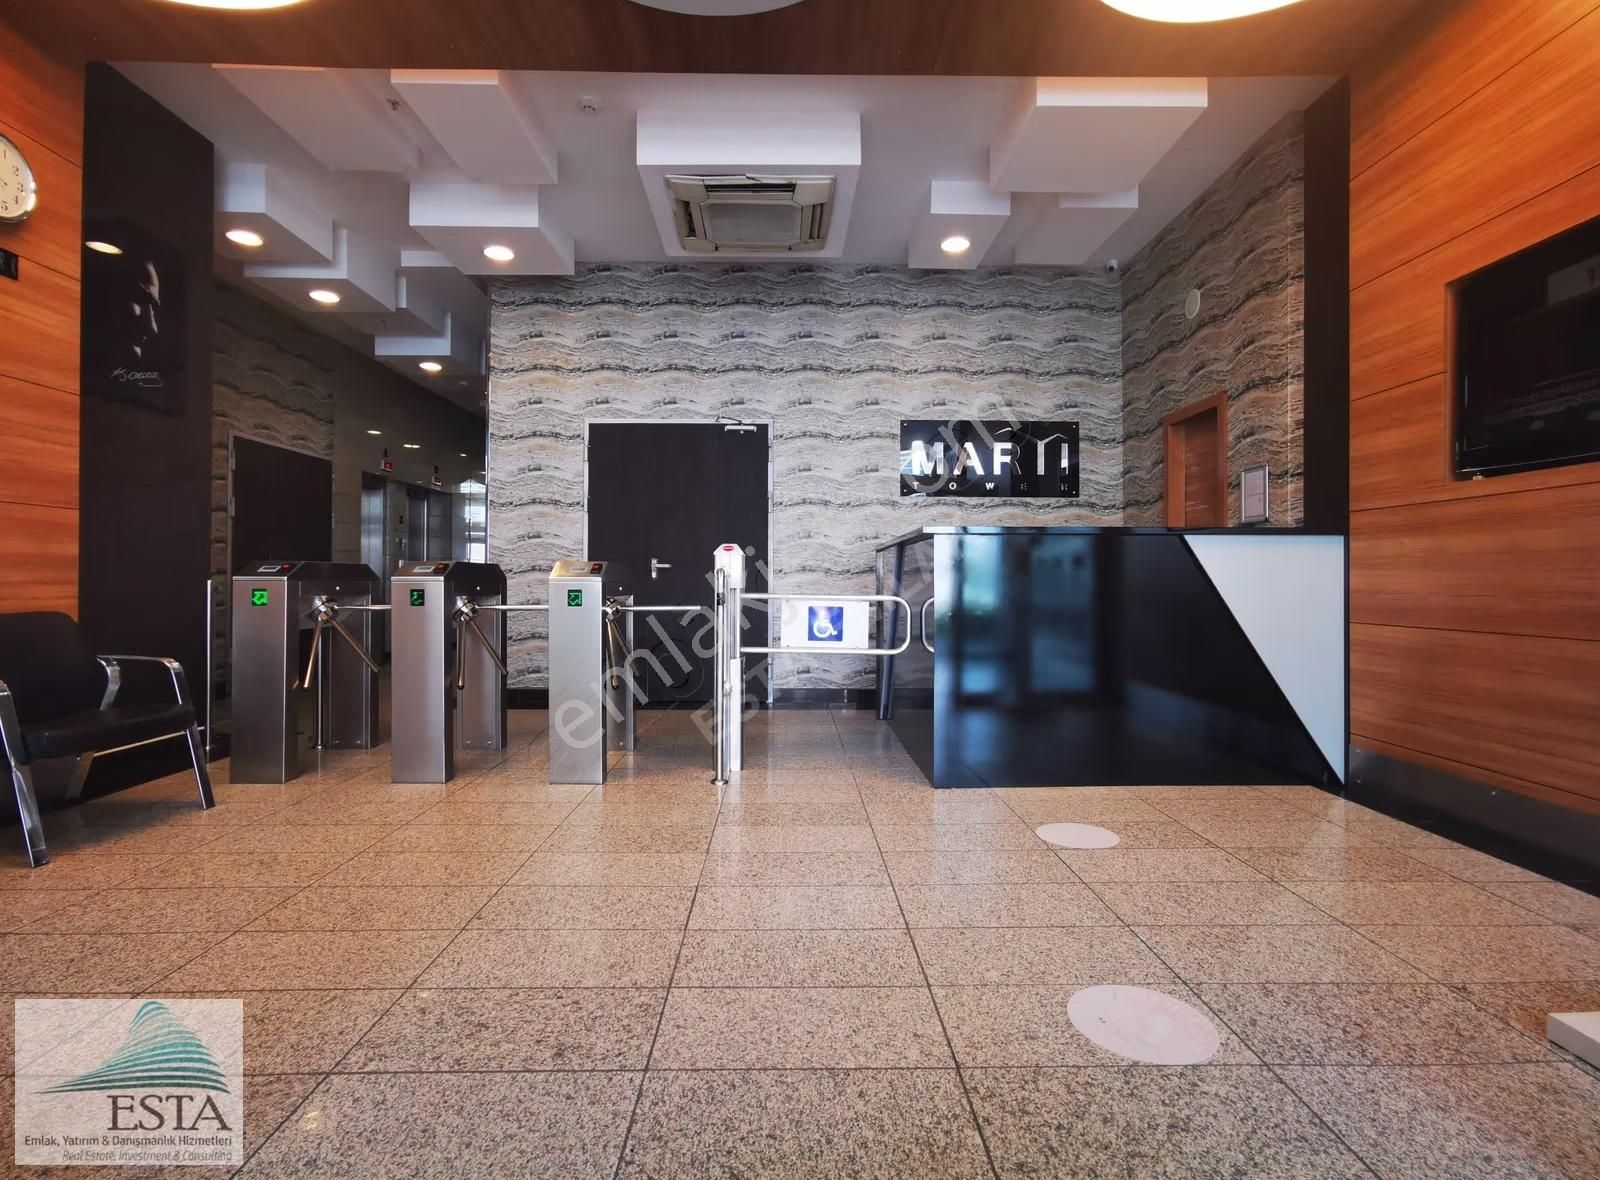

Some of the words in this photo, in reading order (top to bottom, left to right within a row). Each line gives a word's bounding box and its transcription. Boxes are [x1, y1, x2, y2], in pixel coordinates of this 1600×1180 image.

[12, 165, 19, 176] 2
[17, 182, 24, 193] 3
[1, 200, 8, 211] 5
